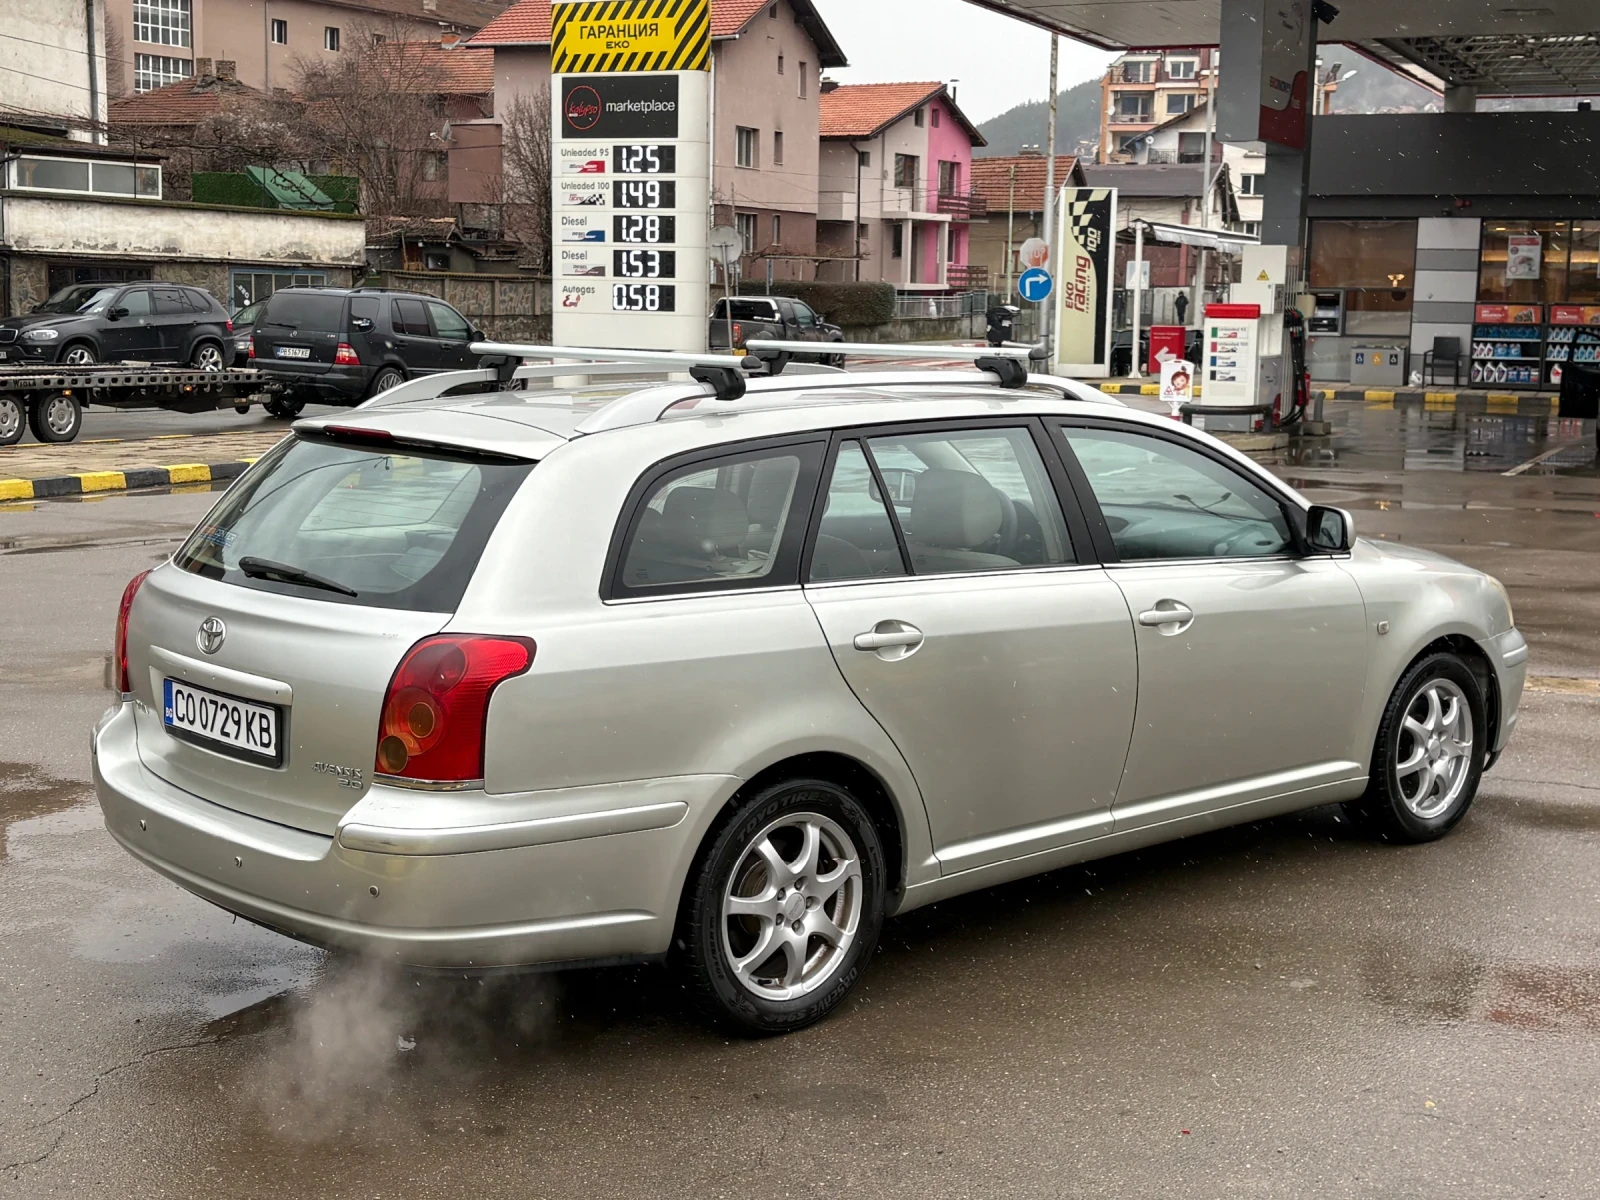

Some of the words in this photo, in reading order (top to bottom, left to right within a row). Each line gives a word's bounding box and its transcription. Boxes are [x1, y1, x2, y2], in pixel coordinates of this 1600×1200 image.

[579, 23, 659, 40] ГАРАНЦИЯ
[606, 40, 630, 49] EKO
[606, 100, 676, 114] marketplace
[561, 148, 598, 156] Unleaded
[599, 148, 609, 156] 95
[621, 145, 660, 173] 1.25
[561, 182, 596, 190] Unleaded
[597, 182, 610, 190] 100
[621, 180, 660, 208] 1.49
[561, 216, 588, 226] Diesel
[621, 215, 660, 243] 1.28
[1086, 227, 1097, 252] 100
[561, 250, 588, 260] Diesel
[621, 250, 660, 277] 1.53
[562, 285, 596, 295] Autogas
[1074, 255, 1091, 312] racing
[613, 284, 660, 311] 0.58
[1065, 282, 1074, 309] EKO
[165, 706, 173, 718] BG
[199, 696, 242, 740] 0729
[311, 761, 363, 779] AVENSIS
